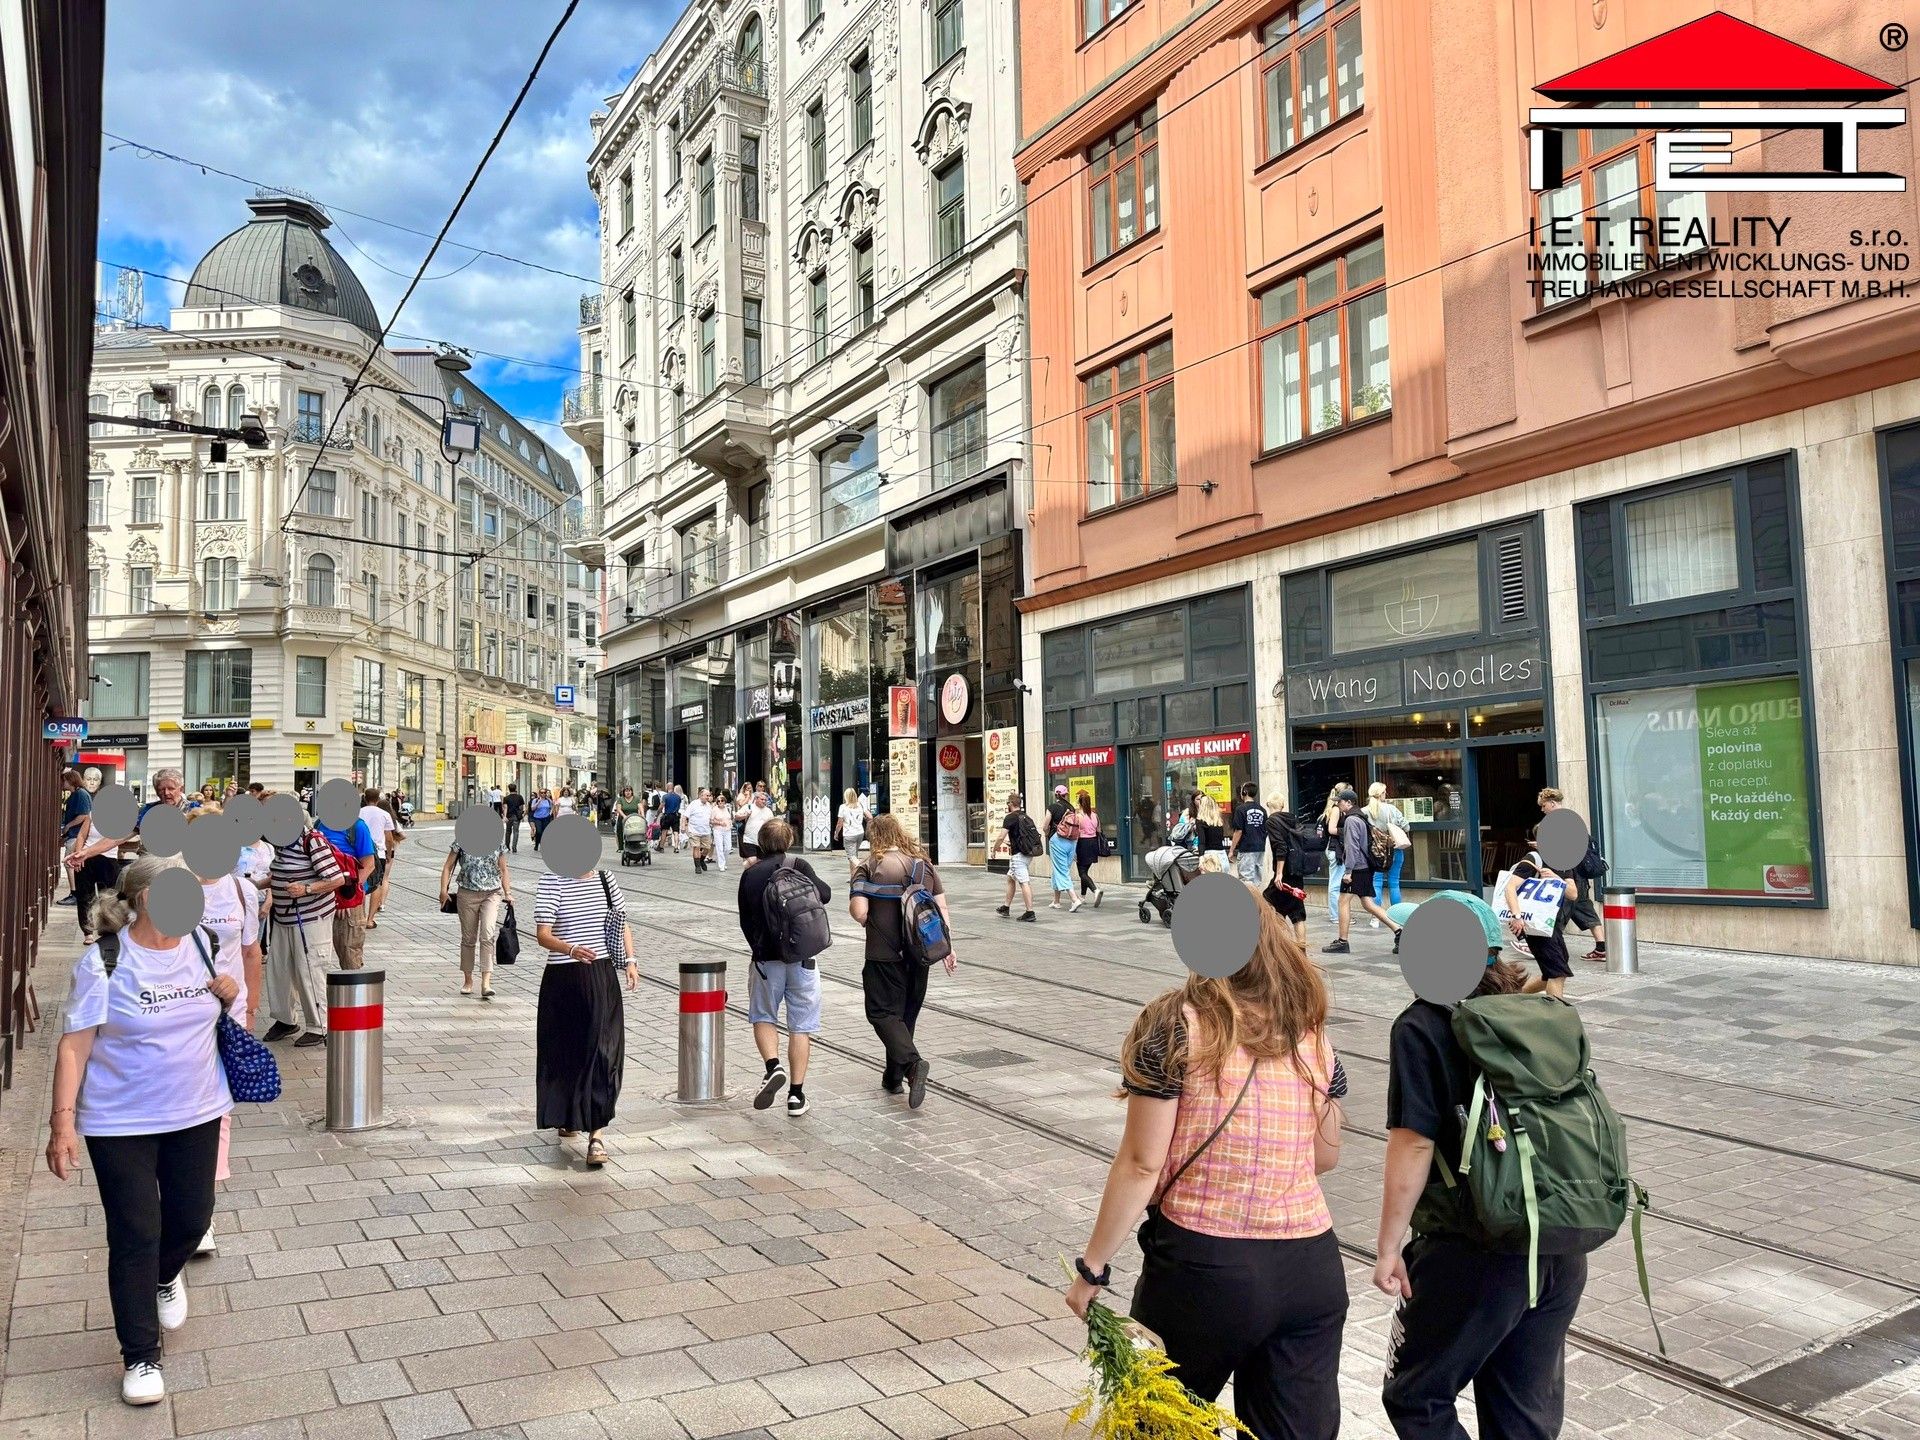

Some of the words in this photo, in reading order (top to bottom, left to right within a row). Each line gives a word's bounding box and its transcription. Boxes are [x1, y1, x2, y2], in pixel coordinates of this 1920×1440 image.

[1308, 675, 1377, 703] Wang
[1413, 654, 1533, 694] Noodles
[812, 706, 853, 728] KRYSTAL
[61, 723, 83, 733] SIM
[190, 721, 226, 729] Raiffeisen
[227, 721, 249, 729] BANK
[1167, 739, 1200, 757] LEVNÉ
[1204, 738, 1242, 754] KNIHY
[1707, 742, 1762, 757] polovina
[1050, 751, 1076, 767] LEVNÉ
[1079, 752, 1108, 765] KNIHY
[1708, 763, 1714, 771] z
[1718, 758, 1772, 772] doplatku
[1709, 779, 1724, 787] na
[1728, 775, 1771, 788] recept.
[1710, 794, 1732, 804] Pro
[1735, 791, 1796, 804] každého.
[1711, 808, 1750, 822] Každý
[1754, 809, 1783, 820] den.
[141, 1005, 160, 1015] 770
